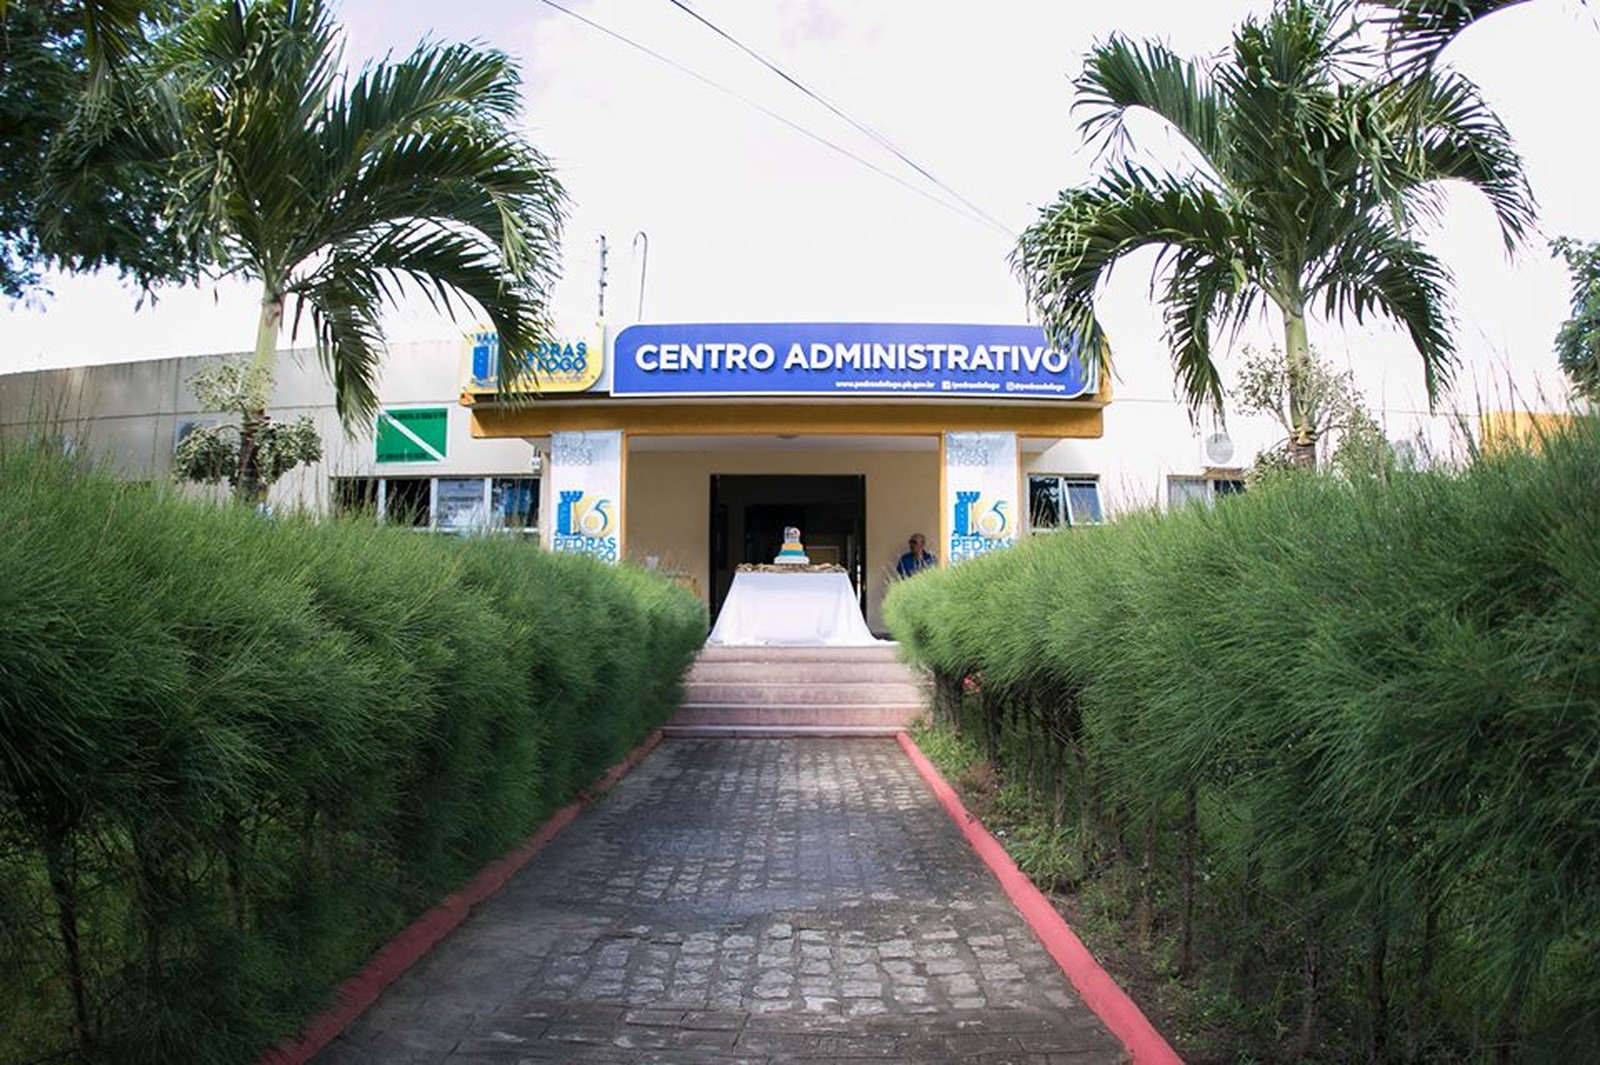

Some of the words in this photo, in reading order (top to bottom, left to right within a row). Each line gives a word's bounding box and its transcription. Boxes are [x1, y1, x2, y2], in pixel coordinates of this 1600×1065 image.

[635, 343, 775, 370] CENTRO
[783, 343, 1068, 373] ADMINISTRATIVO
[553, 536, 617, 551] PEDRAS
[951, 538, 1013, 551] PEDRAS
